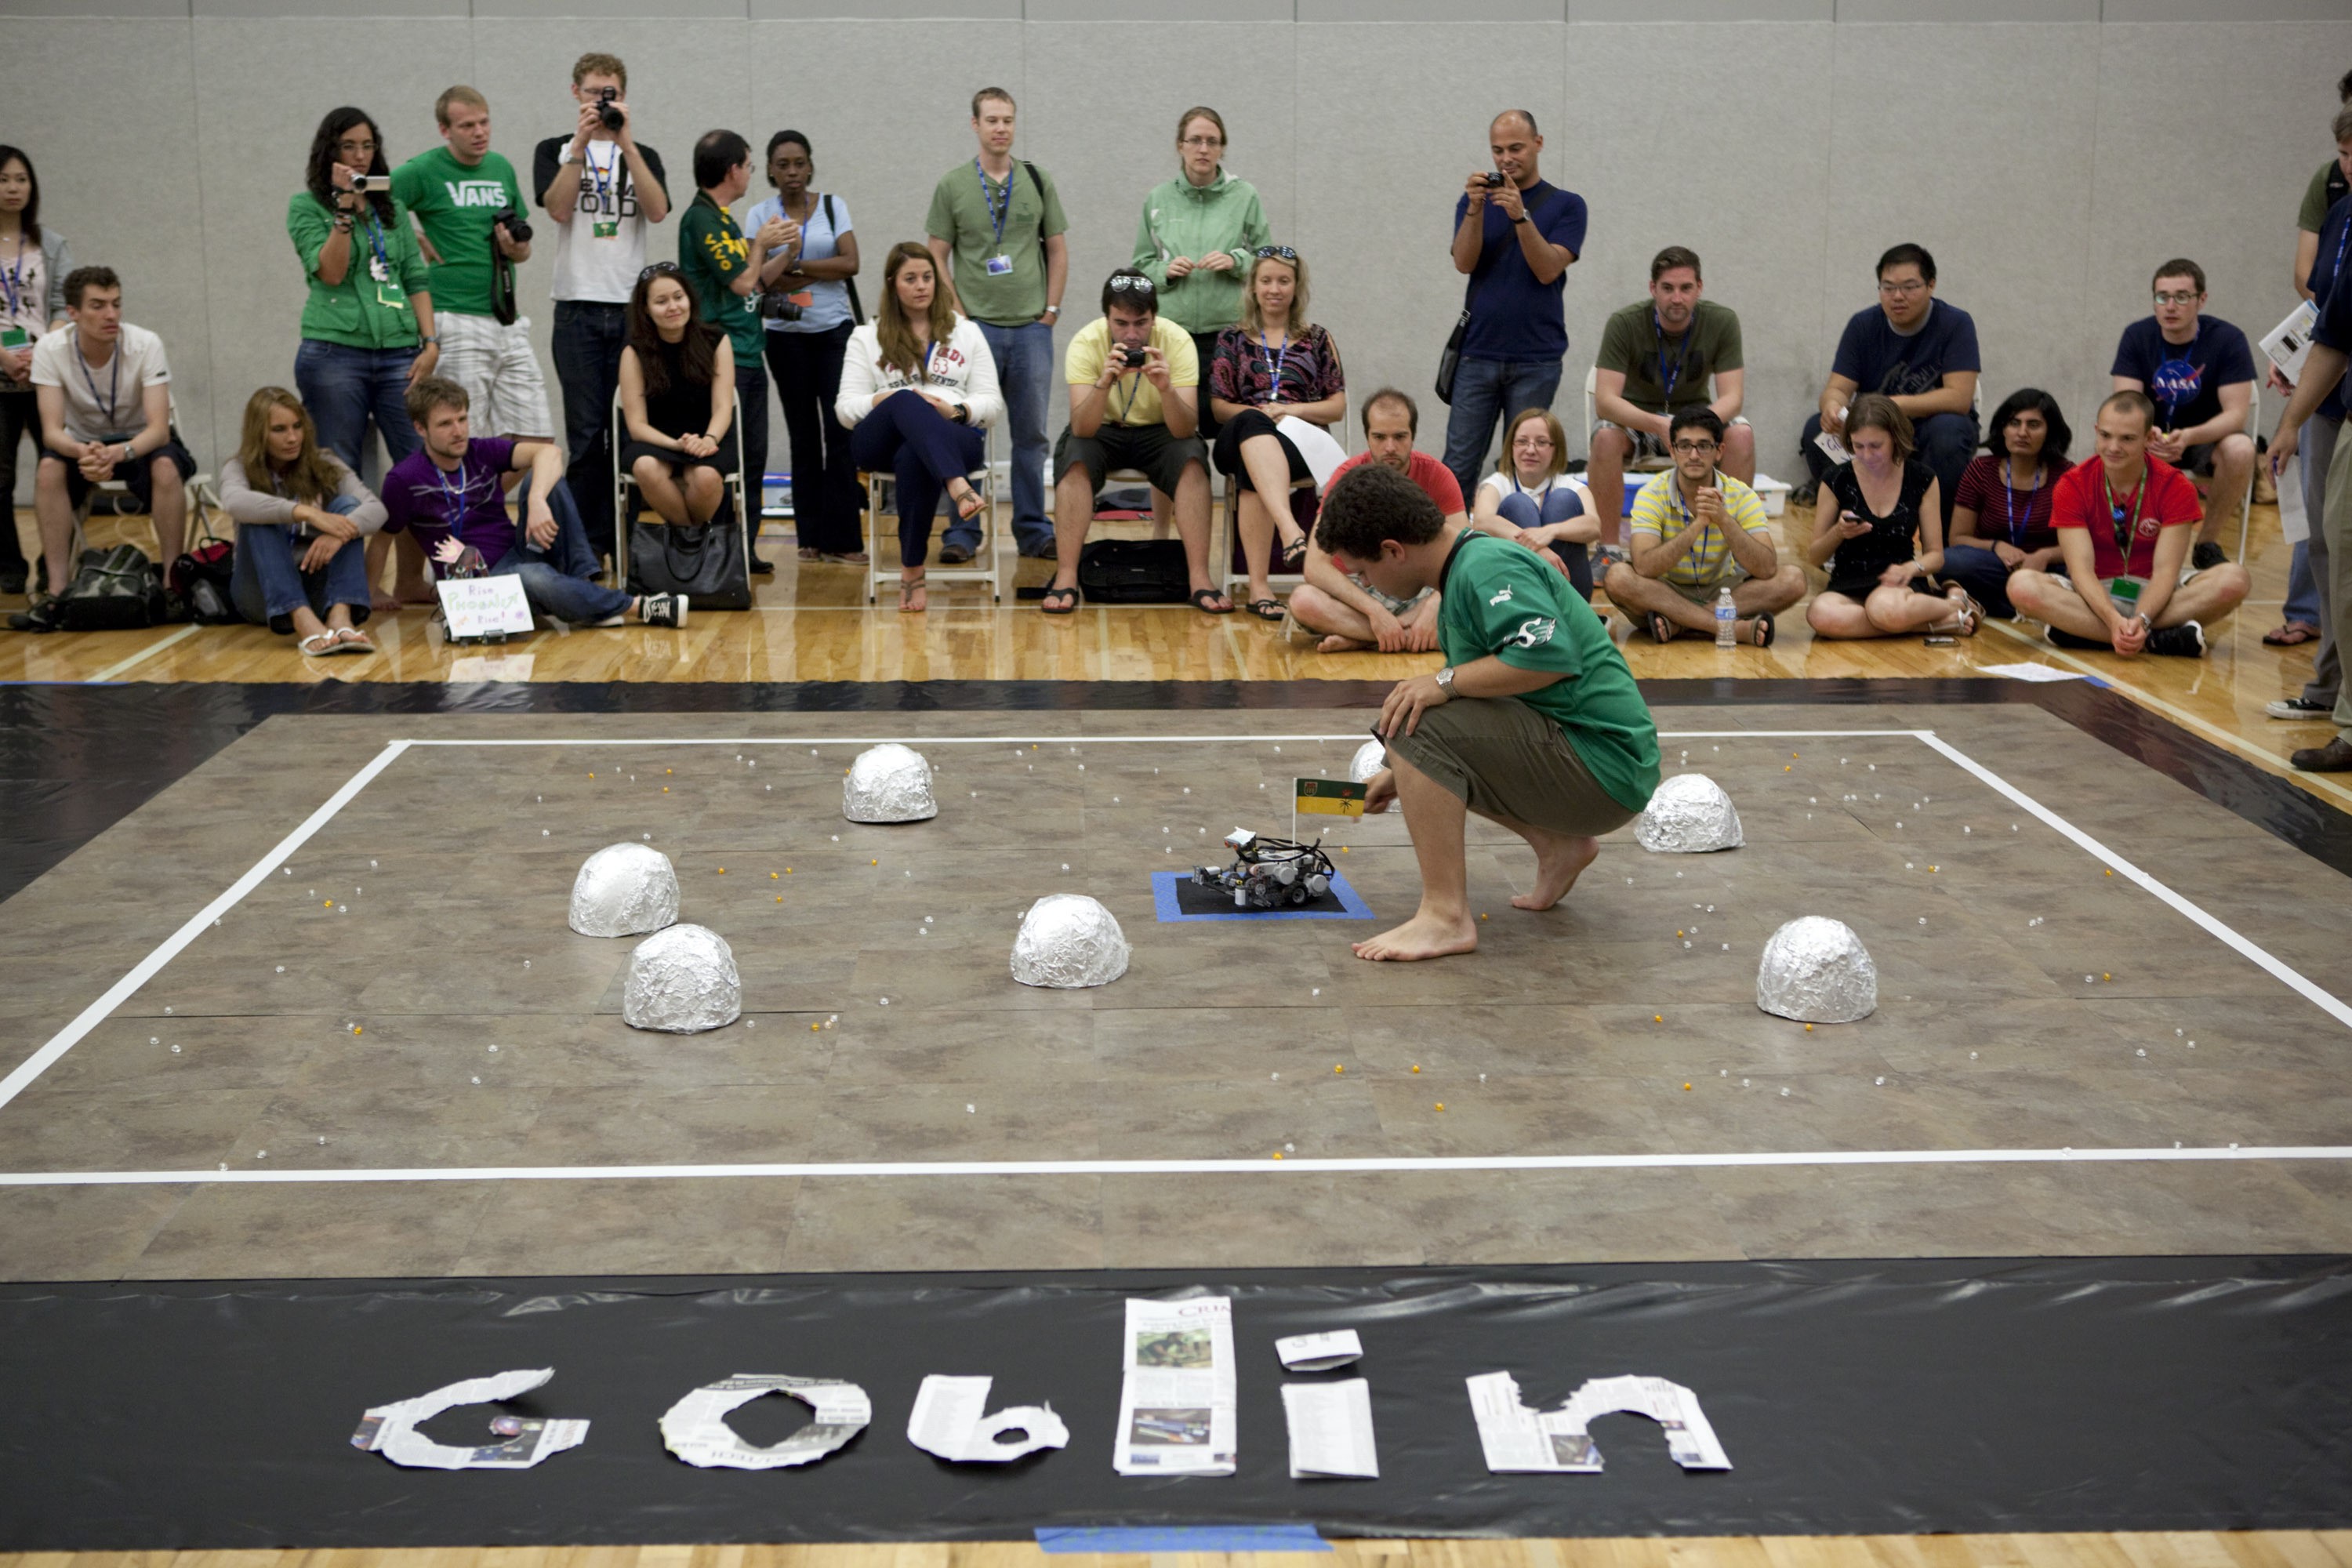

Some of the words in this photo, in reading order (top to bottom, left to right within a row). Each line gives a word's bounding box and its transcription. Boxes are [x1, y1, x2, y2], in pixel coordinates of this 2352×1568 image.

[445, 180, 507, 208] VANS
[2157, 376, 2198, 390] NASA
[469, 585, 493, 596] Rise
